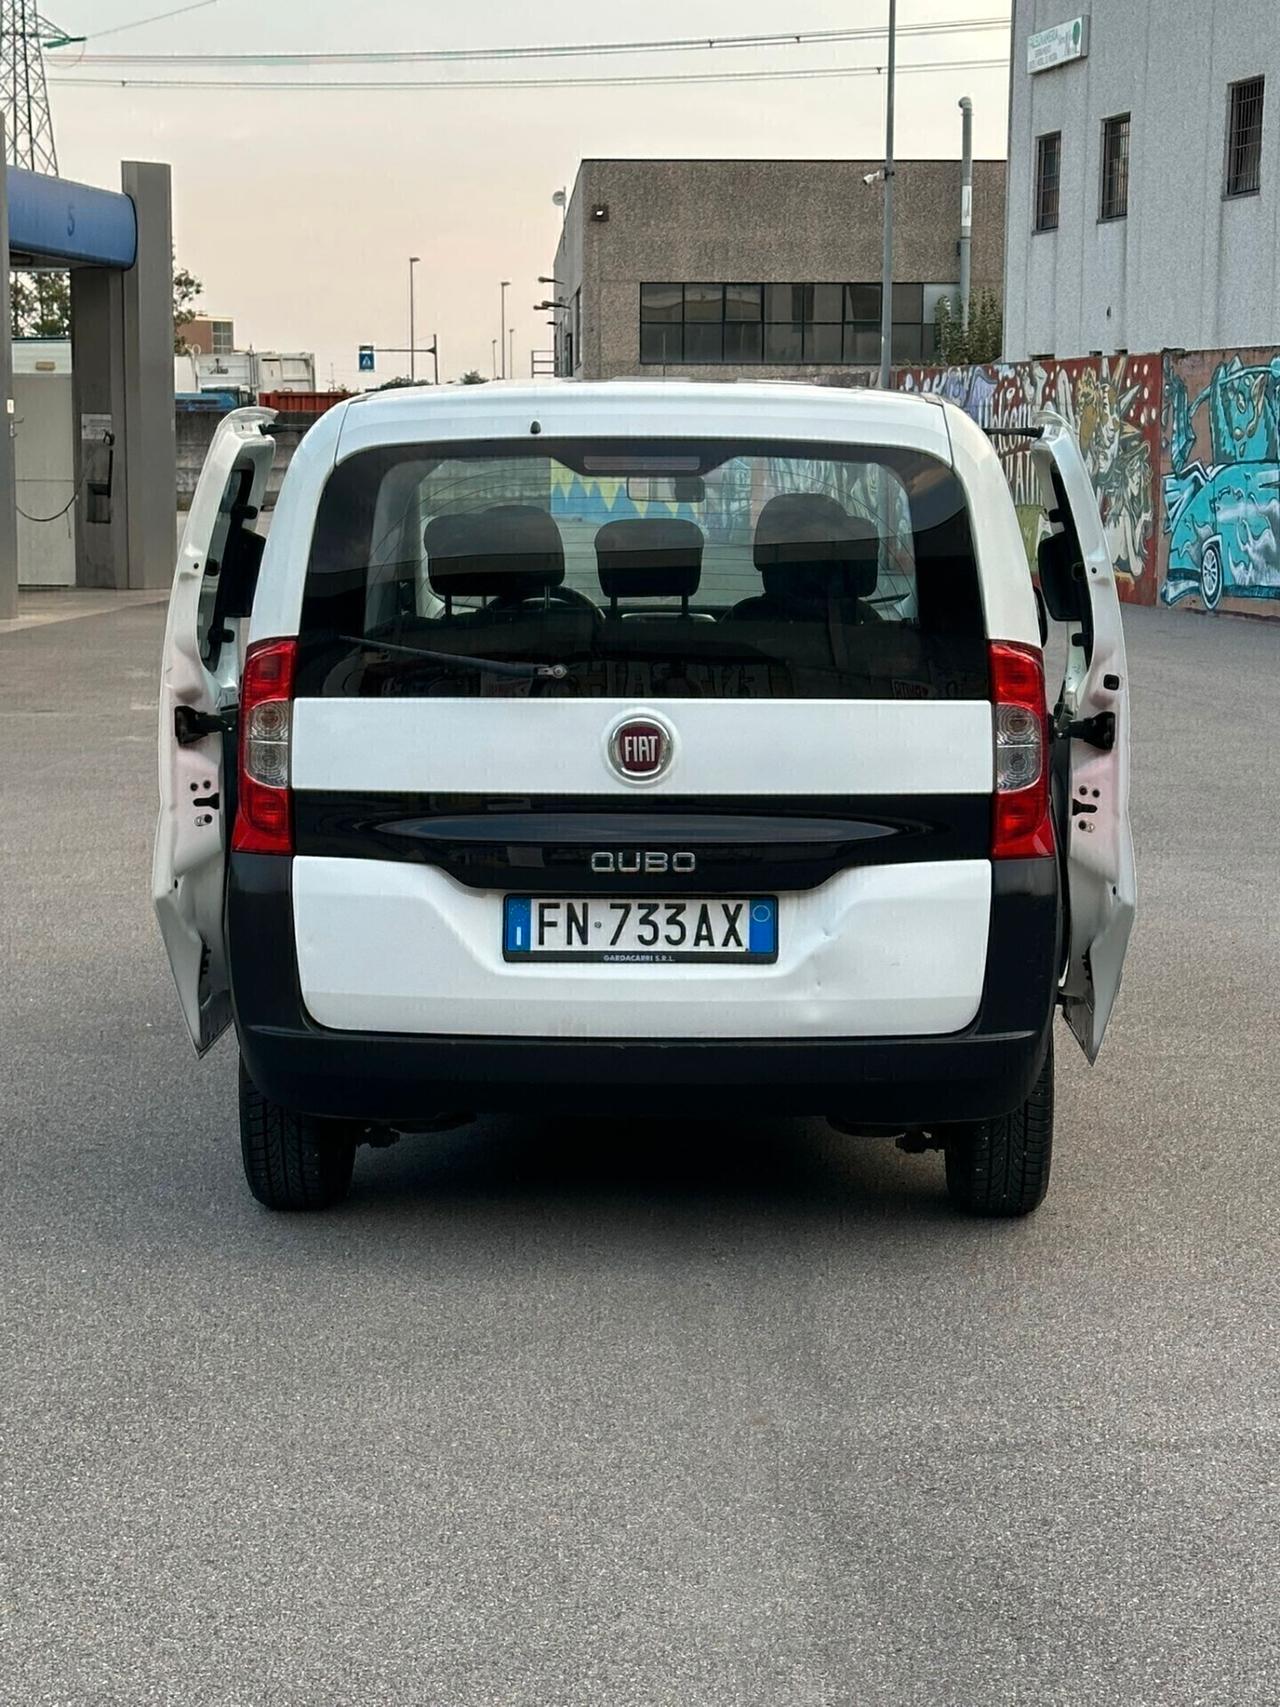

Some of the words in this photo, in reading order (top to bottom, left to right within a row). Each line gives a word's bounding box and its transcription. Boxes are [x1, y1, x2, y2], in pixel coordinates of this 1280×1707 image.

[67, 204, 76, 237] 5
[624, 735, 658, 763] FIAT
[591, 851, 696, 873] QUBO
